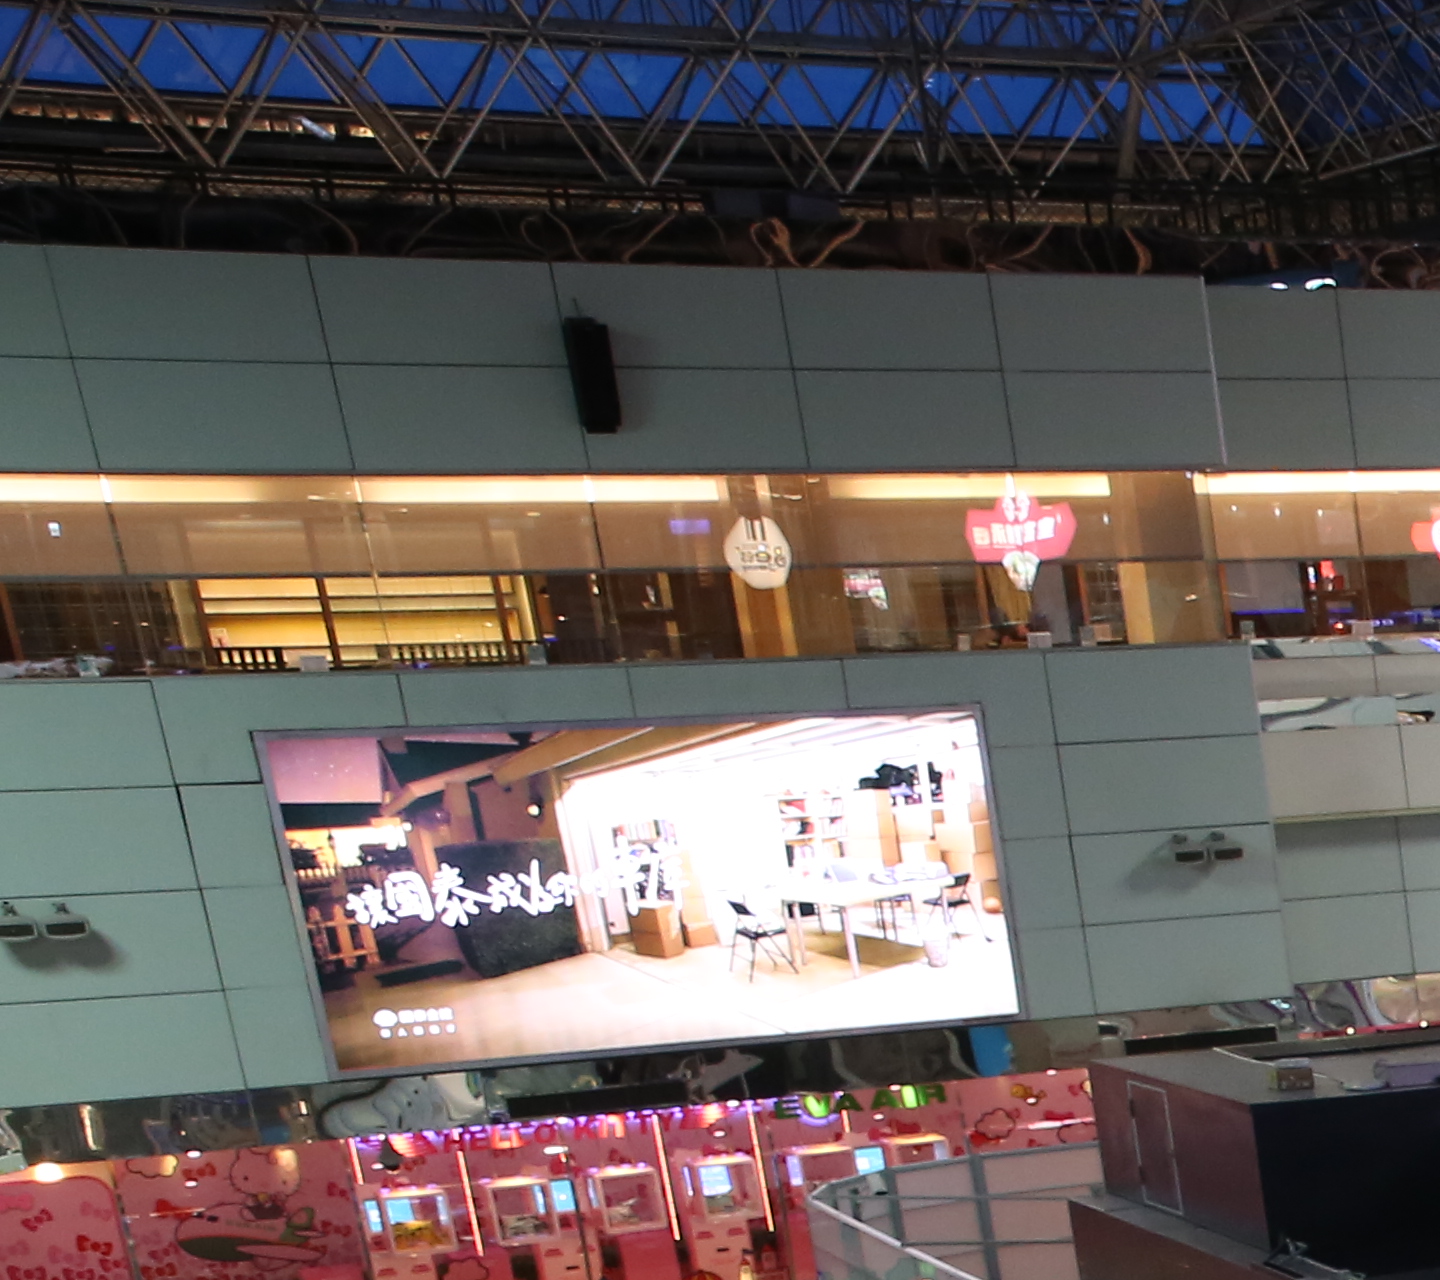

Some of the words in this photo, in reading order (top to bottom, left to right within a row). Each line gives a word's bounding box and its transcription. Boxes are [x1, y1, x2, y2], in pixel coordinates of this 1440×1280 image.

[775, 1091, 863, 1120] EVA
[871, 1083, 949, 1110] AIR
[440, 1121, 558, 1155] HELLO
[573, 1110, 673, 1143] KITTY
